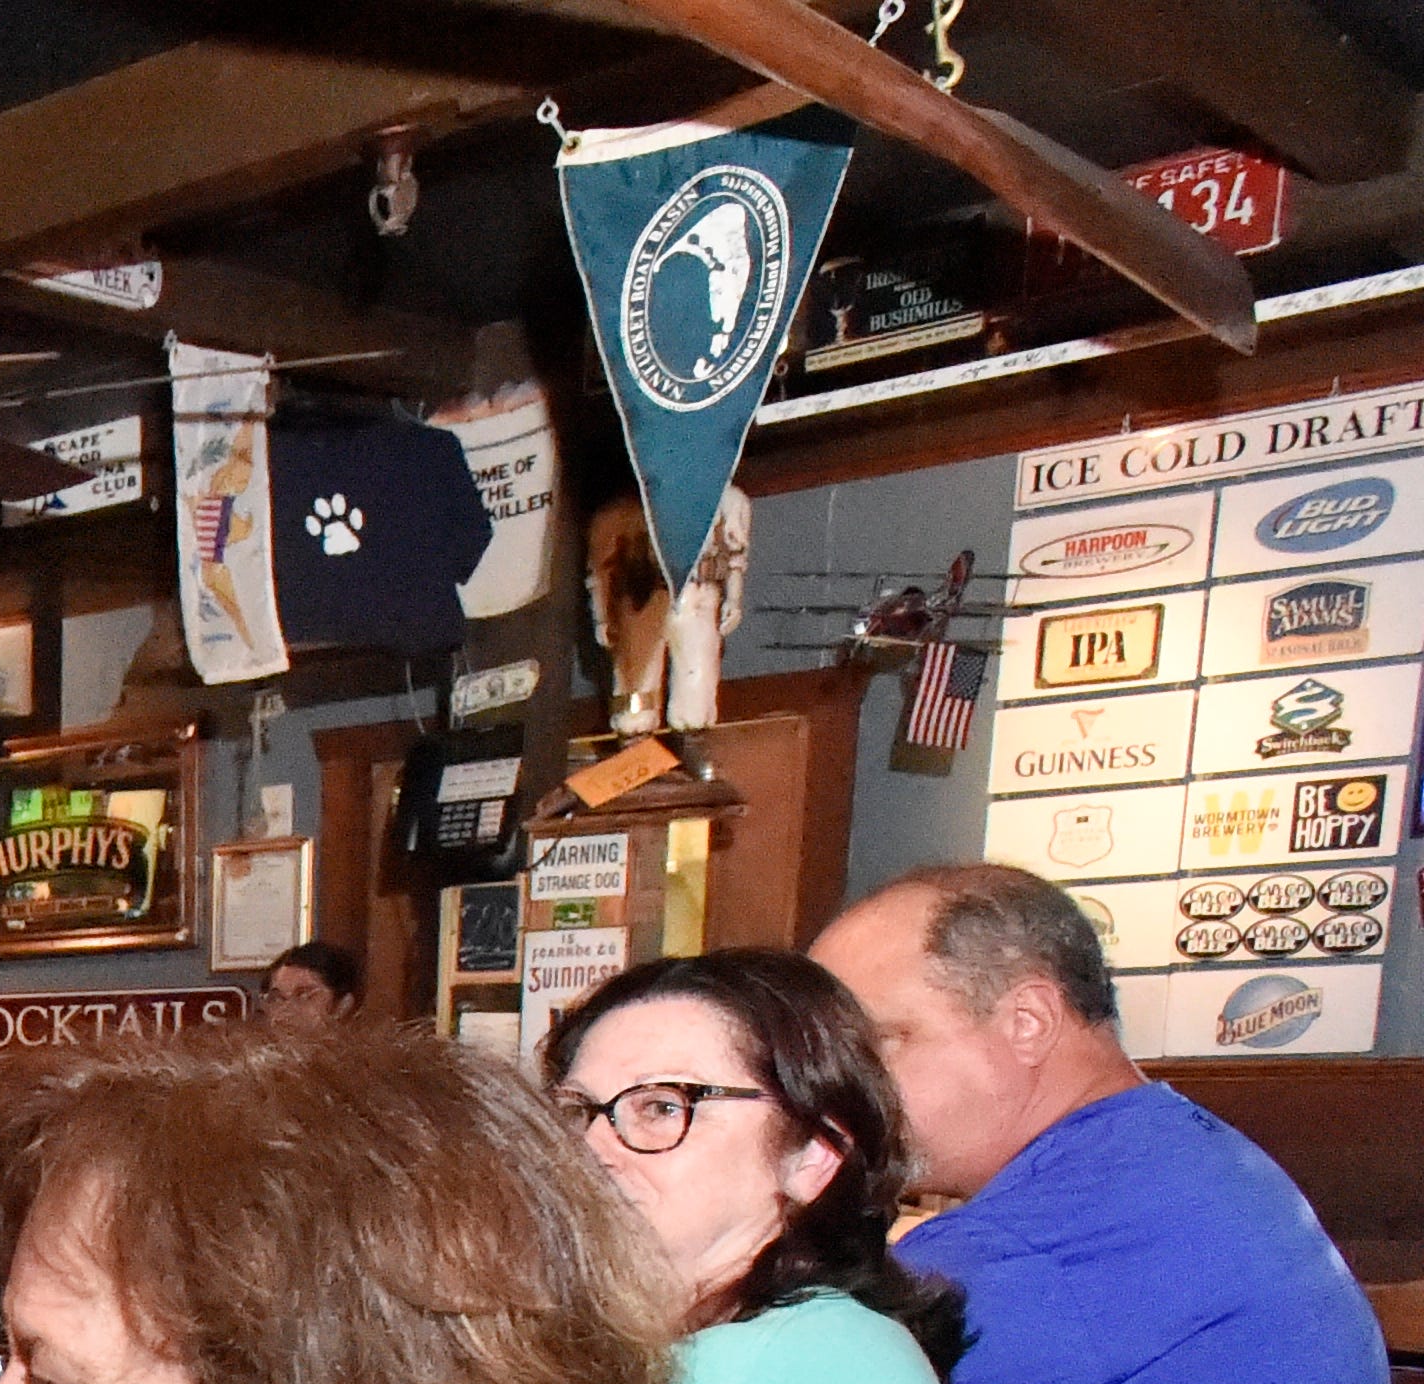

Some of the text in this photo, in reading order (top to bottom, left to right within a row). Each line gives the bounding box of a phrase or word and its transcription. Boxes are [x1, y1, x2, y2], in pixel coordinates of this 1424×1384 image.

[1160, 152, 1261, 187] SAFET
[93, 262, 132, 294] WEEK
[629, 187, 700, 400] NANTUCKET BOAT BASIN
[900, 287, 932, 308] OLD
[708, 313, 769, 390] Nantucket
[759, 257, 780, 309] Island
[869, 299, 964, 332] BUSHMILLS
[471, 454, 537, 482] OME OF
[1031, 454, 1100, 493] ICE
[1120, 431, 1246, 478] COLD
[91, 475, 137, 495] CLUB
[480, 482, 514, 502] HE
[1275, 494, 1388, 539] BUD LIGHT
[1064, 530, 1148, 557] HARPOON
[1271, 589, 1363, 635] SAMUEL ADAMS
[1068, 630, 1126, 668] IPA
[1260, 732, 1345, 754] Switchback
[1014, 744, 1156, 778] GUINNESS
[1194, 808, 1280, 826] WORMTOWN
[1299, 784, 1334, 818] BE
[1193, 822, 1265, 839] BREWERY
[1295, 813, 1377, 849] HOPPY
[543, 842, 619, 868] WARNING
[537, 874, 591, 893] STRANGE
[1216, 991, 1320, 1046] BLUE MOON
